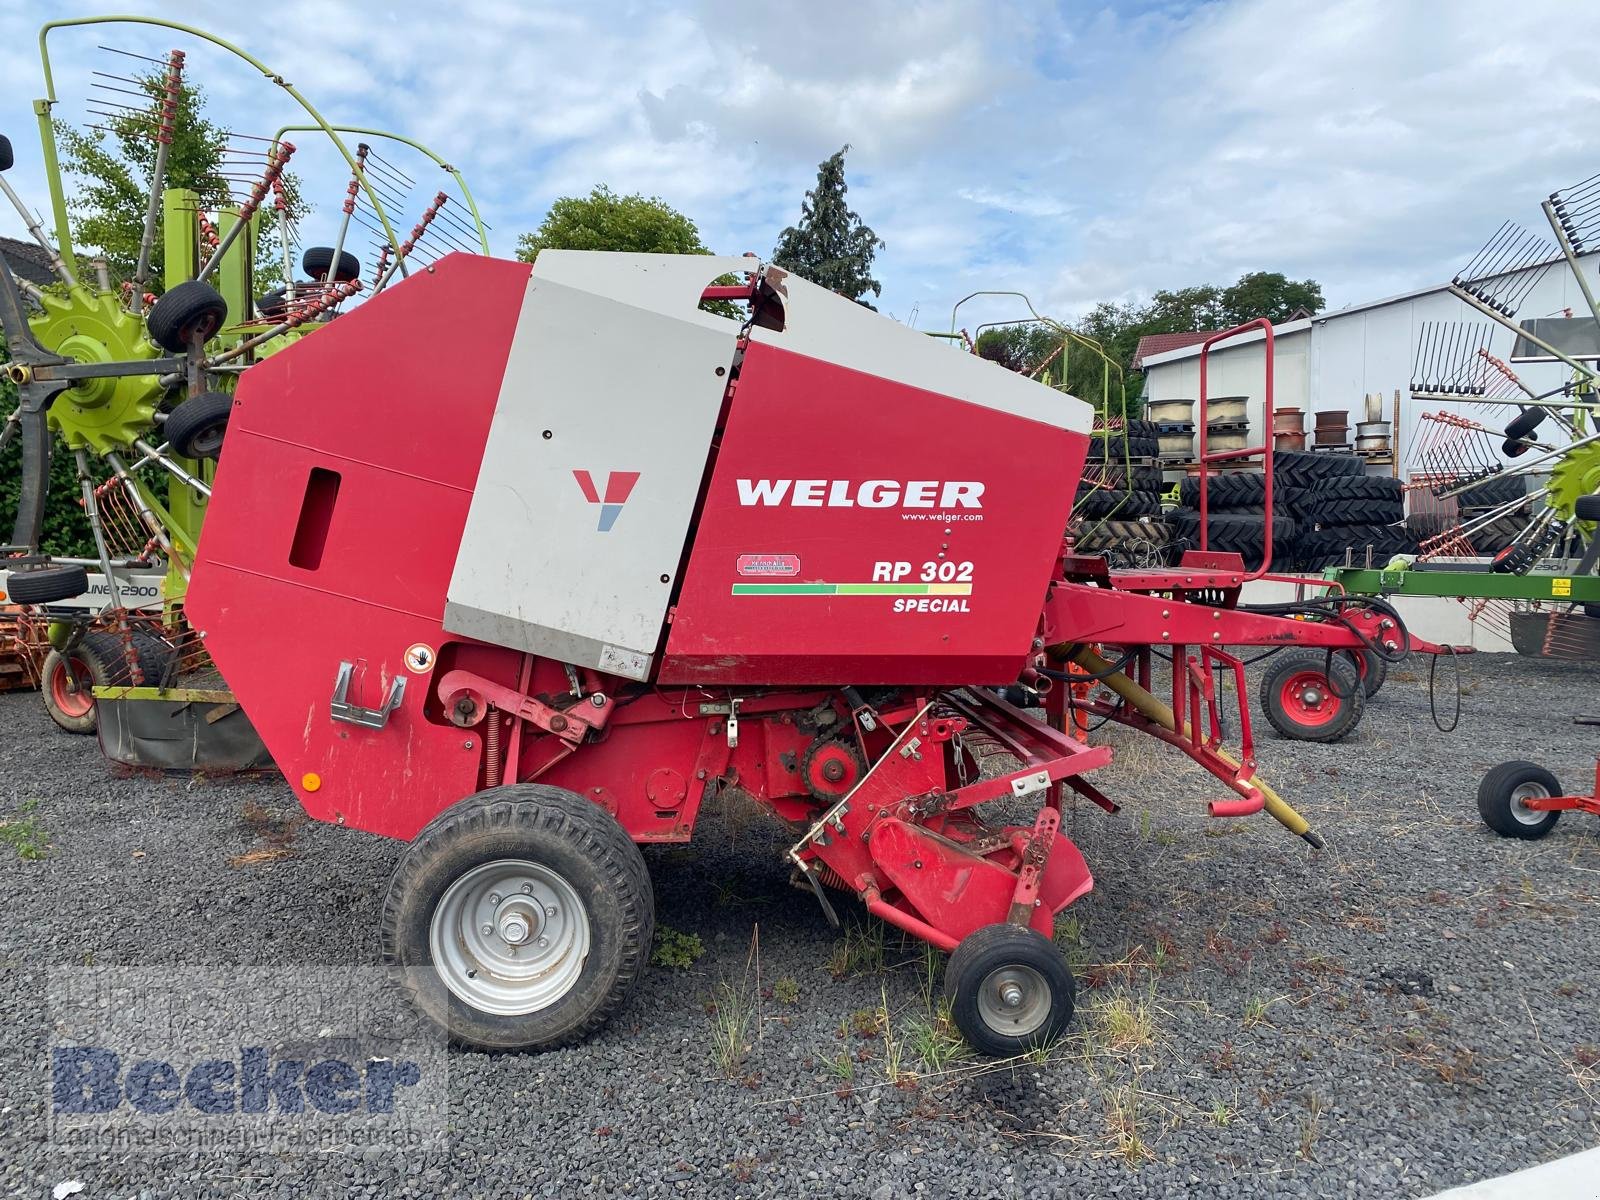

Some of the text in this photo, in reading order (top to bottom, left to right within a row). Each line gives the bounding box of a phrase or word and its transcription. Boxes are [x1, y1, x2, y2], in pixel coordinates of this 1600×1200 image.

[736, 479, 985, 508] WELGER
[901, 512, 984, 523] www.welger.com
[872, 561, 975, 582] RP 302
[120, 585, 157, 596] 2900
[893, 598, 971, 613] SPECIAL
